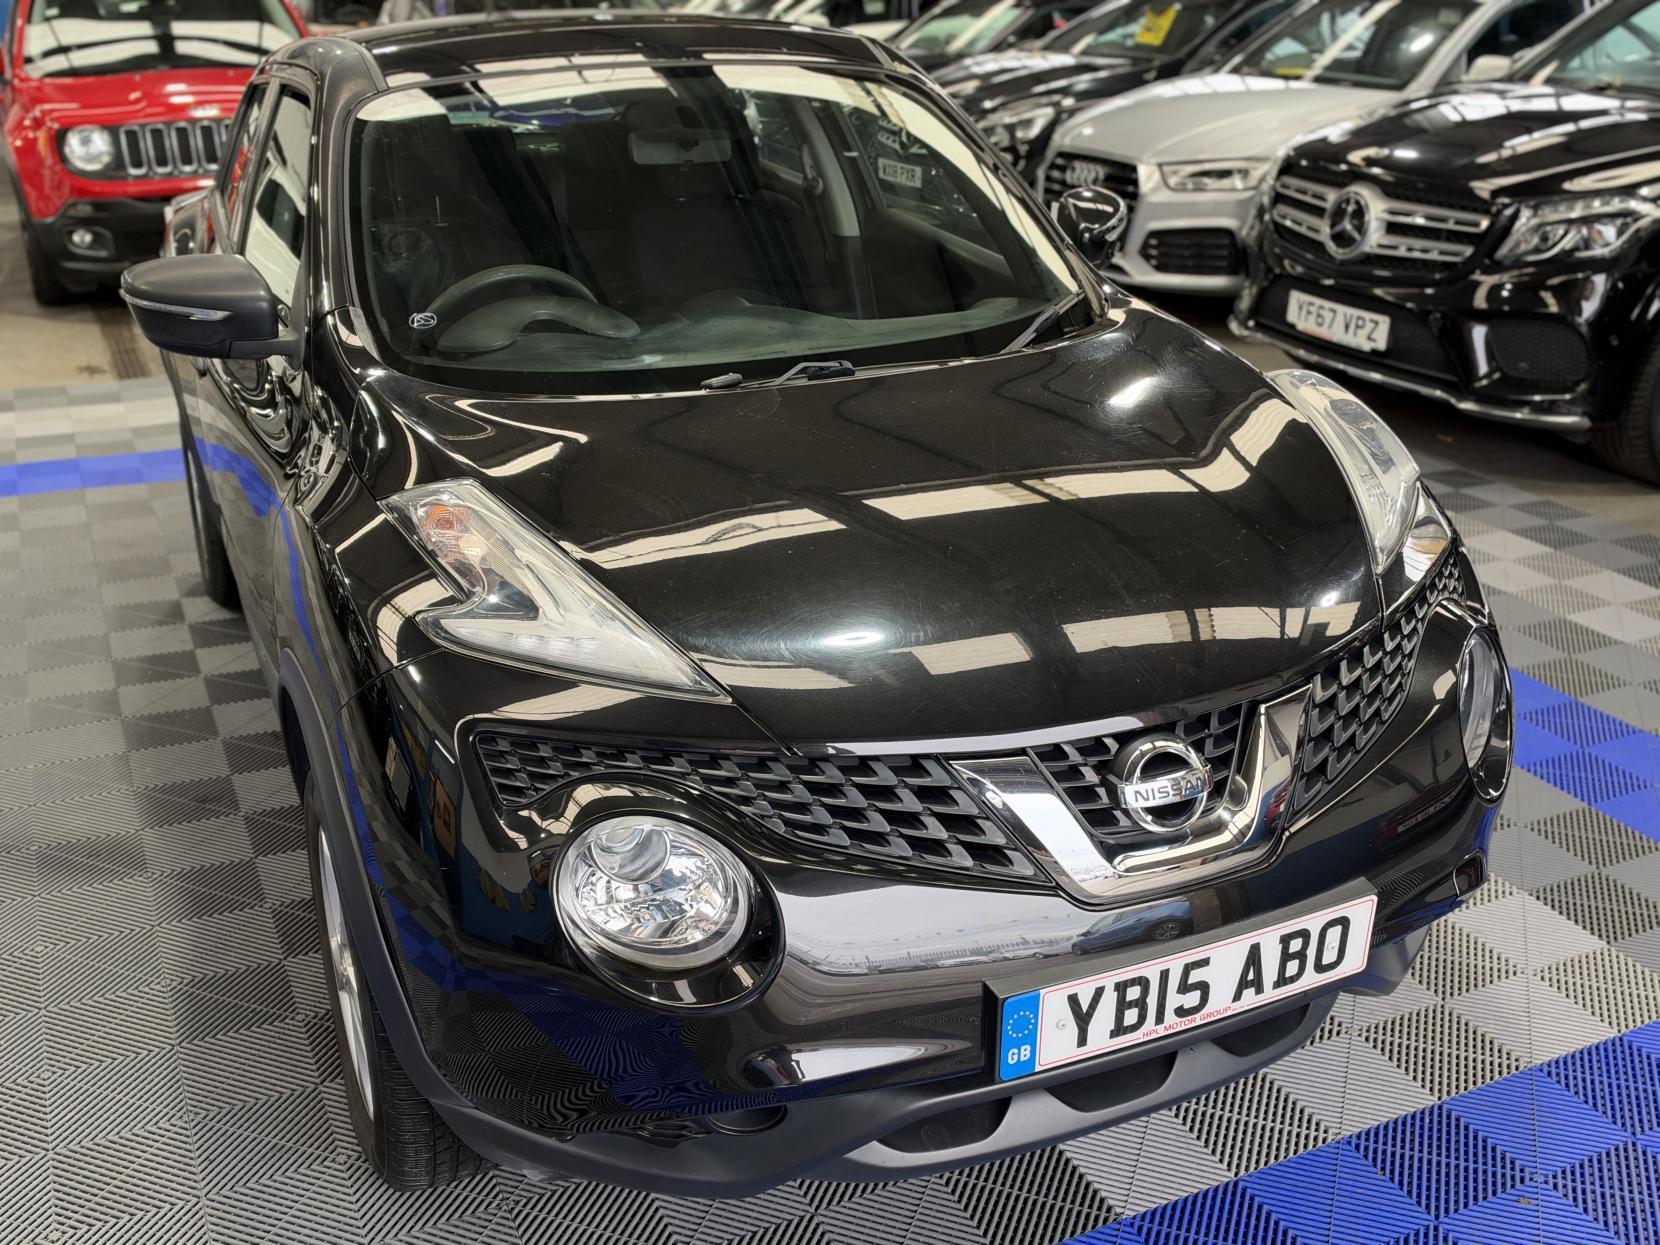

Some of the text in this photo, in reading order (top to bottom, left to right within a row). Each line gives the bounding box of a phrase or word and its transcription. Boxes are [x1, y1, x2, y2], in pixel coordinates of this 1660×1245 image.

[1296, 298, 1337, 329] YF67
[1343, 312, 1379, 343] VPZ
[1133, 774, 1208, 803] NISSAN
[1066, 915, 1352, 1049] YB15 ABO
[1142, 1028, 1160, 1040] HPL
[1163, 1017, 1197, 1033] MOTOR
[1199, 1005, 1232, 1022] GROUP
[1007, 1044, 1031, 1065] GB
